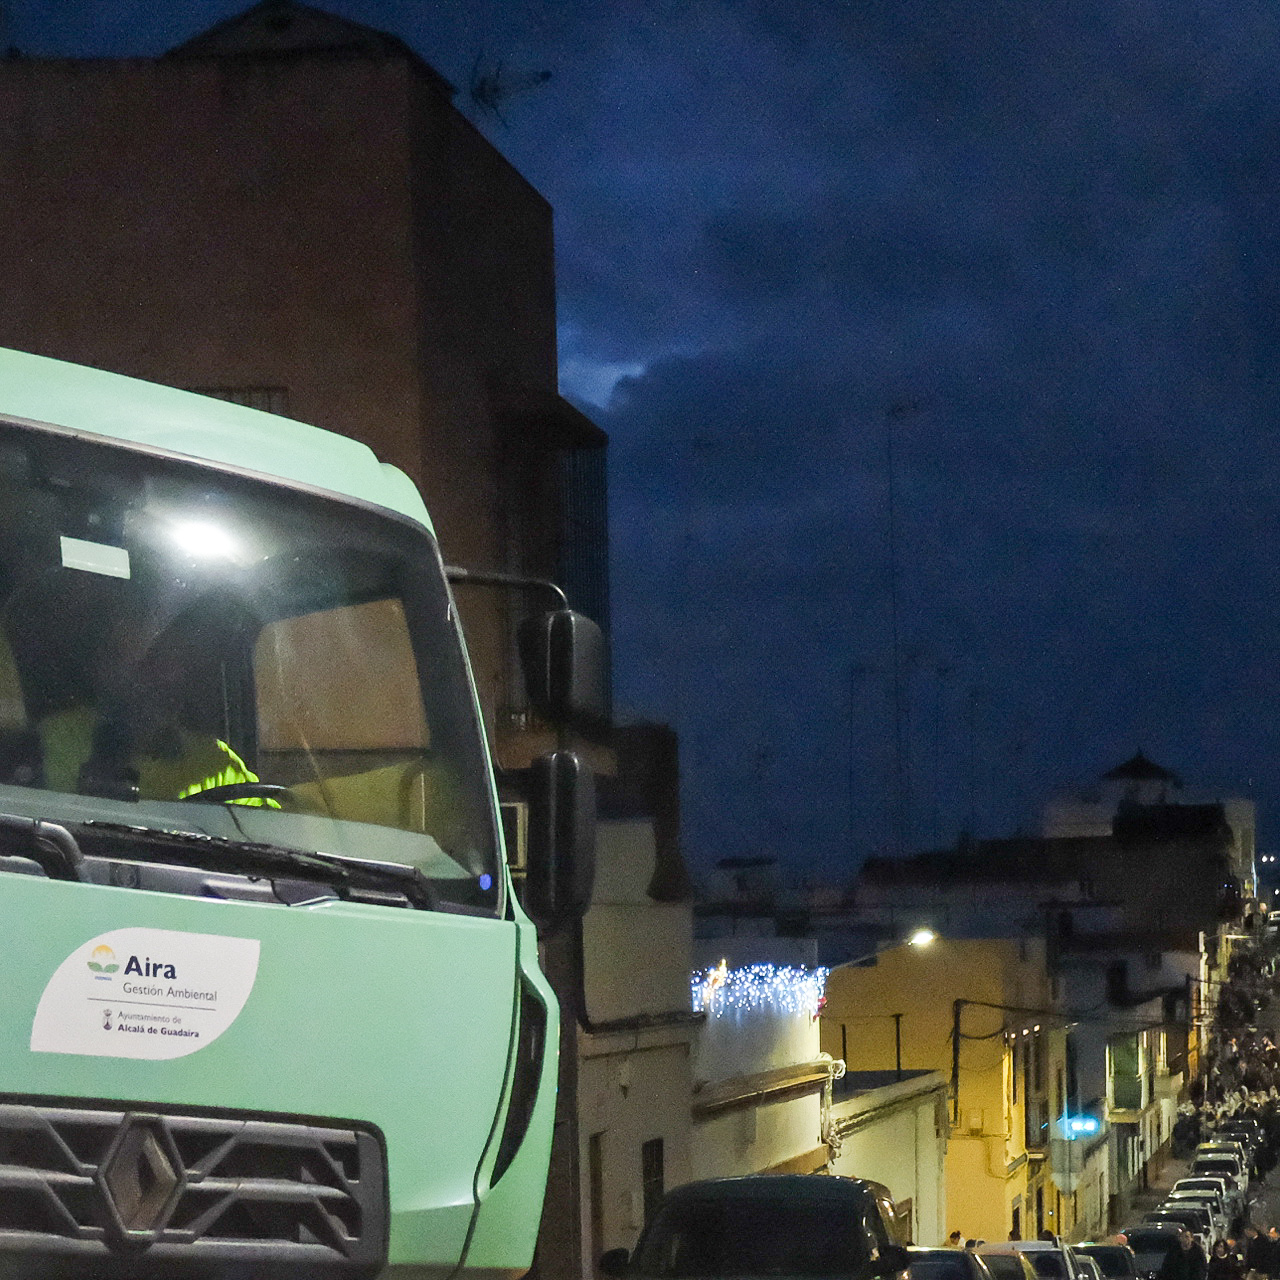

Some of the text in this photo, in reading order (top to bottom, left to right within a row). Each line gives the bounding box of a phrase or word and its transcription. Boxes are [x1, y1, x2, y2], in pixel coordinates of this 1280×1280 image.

[124, 955, 177, 980] Aira
[123, 982, 218, 1001] Gestión Ambiental
[117, 1011, 182, 1024] Ayuntamiento de
[117, 1024, 145, 1033] Alcalá
[147, 1025, 158, 1035] de
